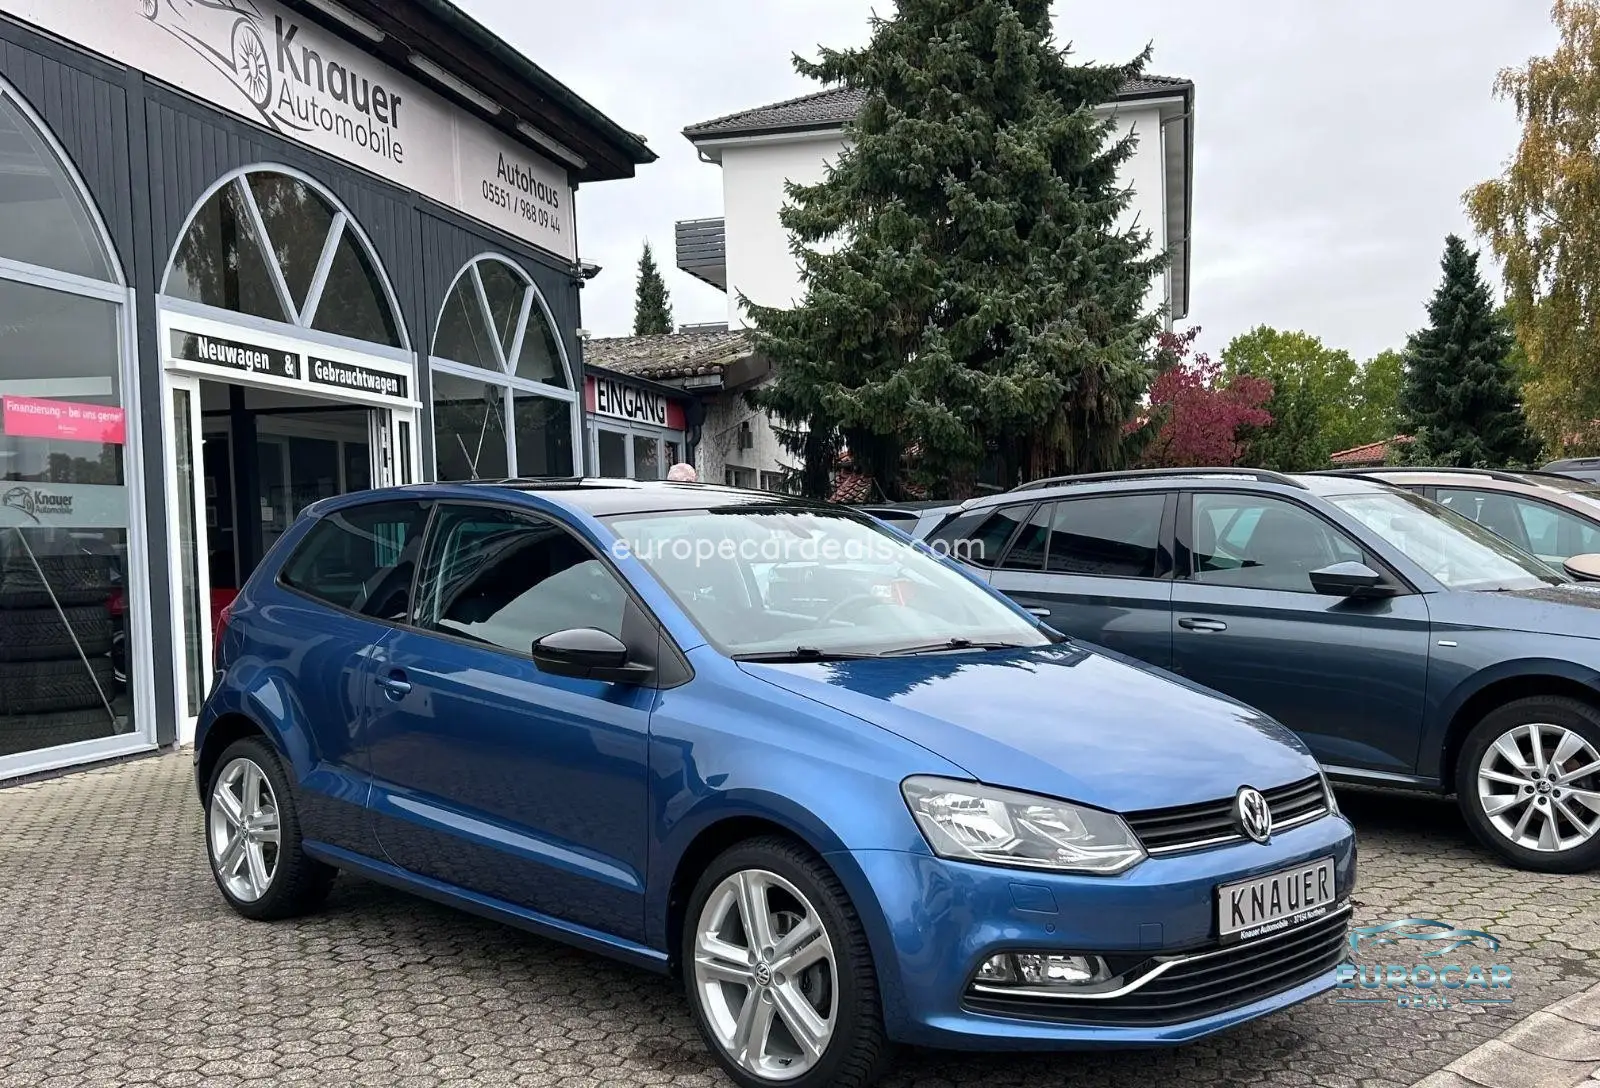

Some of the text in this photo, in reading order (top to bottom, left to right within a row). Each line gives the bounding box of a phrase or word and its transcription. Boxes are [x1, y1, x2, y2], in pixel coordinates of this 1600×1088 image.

[274, 14, 402, 129] Knauer
[277, 78, 403, 164] Automobile
[482, 180, 511, 211] 05551
[520, 199, 537, 223] 988
[538, 208, 549, 228] 09
[550, 215, 561, 235] 44
[497, 152, 559, 209] Autohaus
[197, 336, 398, 395] Neuwagen & Gebrauchtwagen
[6, 400, 61, 418] Finanzierung
[68, 406, 81, 418] bei
[82, 411, 97, 419] uns
[596, 378, 665, 424] EINGANG
[34, 490, 73, 506] Knauer
[35, 505, 73, 514] Automobile
[1231, 865, 1329, 927] KNAUER
[1240, 928, 1260, 940] Knauer
[1260, 919, 1289, 934] Automobile
